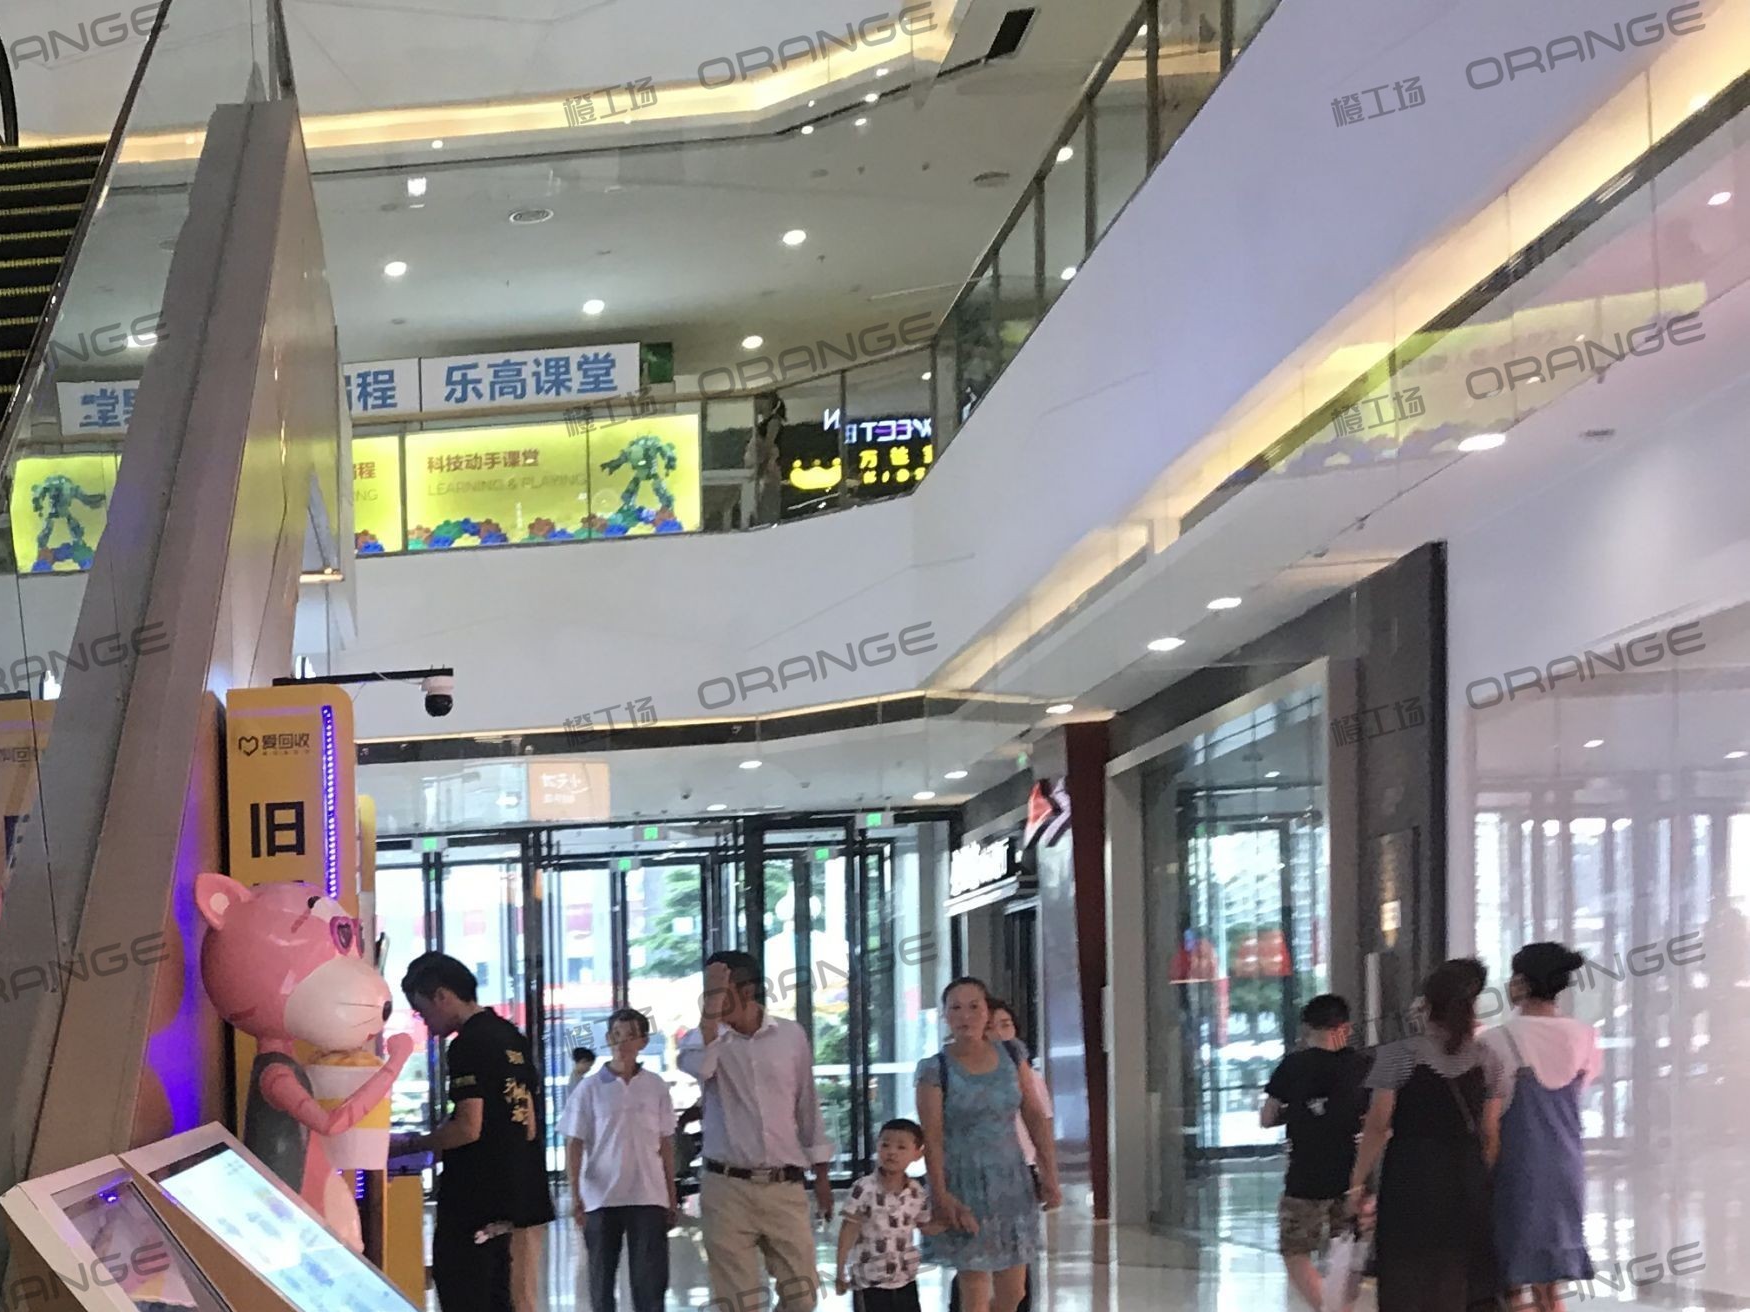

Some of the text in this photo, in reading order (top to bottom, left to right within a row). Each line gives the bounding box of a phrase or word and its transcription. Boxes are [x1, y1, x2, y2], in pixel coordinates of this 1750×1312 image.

[345, 368, 398, 411] 程
[444, 352, 619, 404] 乐高课堂
[428, 448, 539, 473] 科技动手课堂
[262, 733, 310, 749] 爱回收
